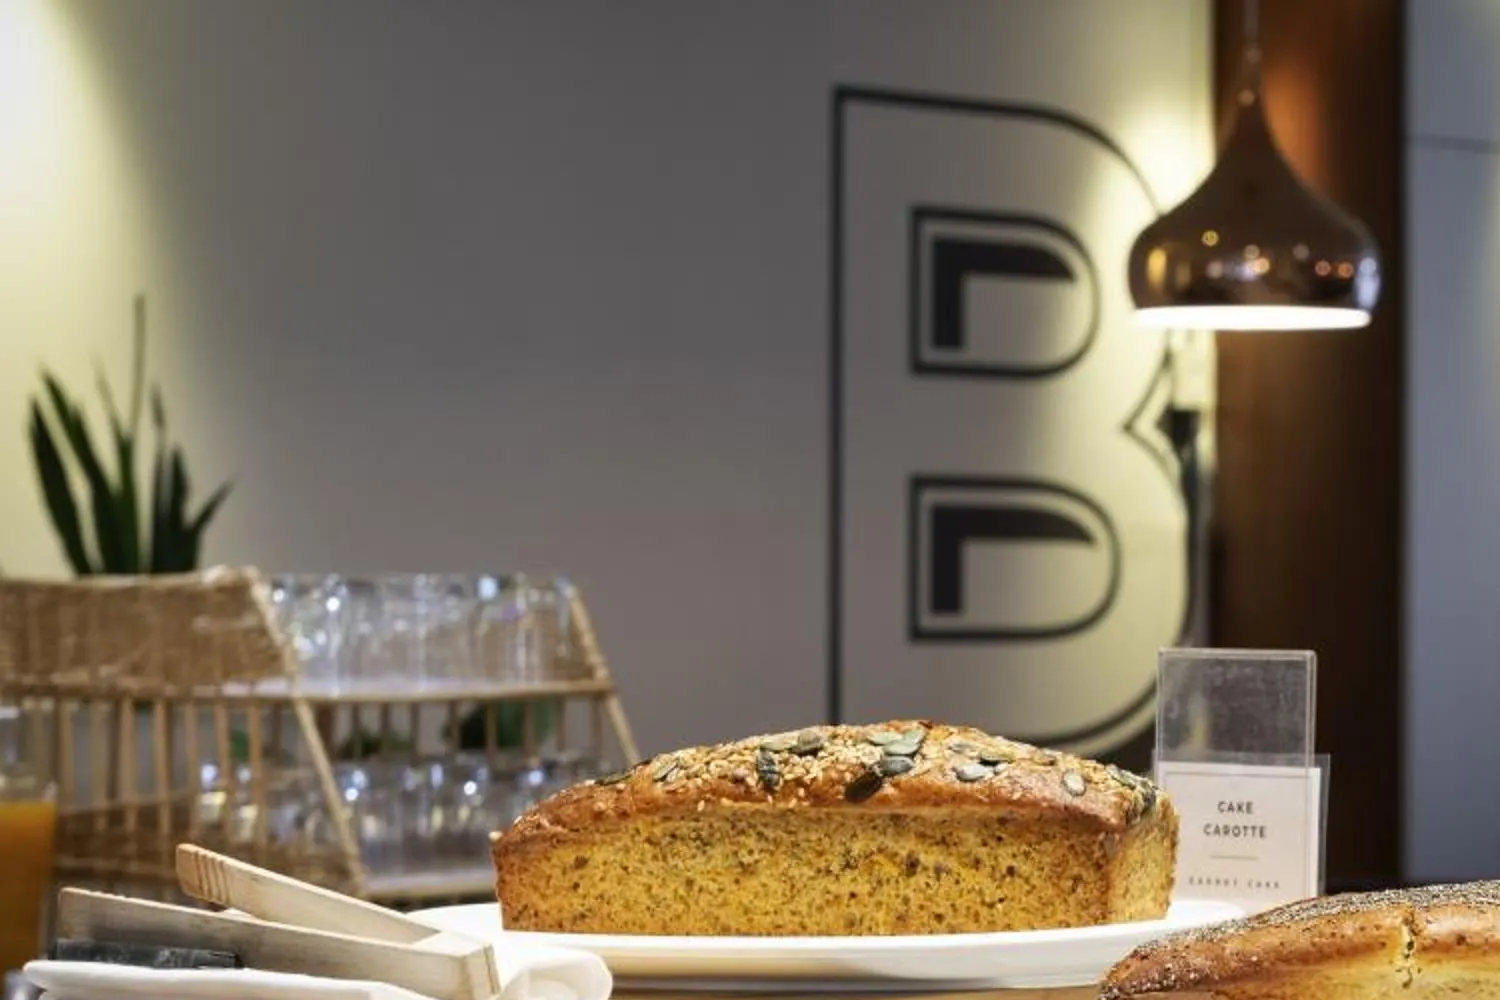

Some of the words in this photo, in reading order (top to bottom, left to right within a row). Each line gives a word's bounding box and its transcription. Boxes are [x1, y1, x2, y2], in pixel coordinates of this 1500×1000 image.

[827, 83, 1208, 756] B
[1216, 801, 1254, 815] CAKE
[1203, 823, 1268, 839] CAROTTE
